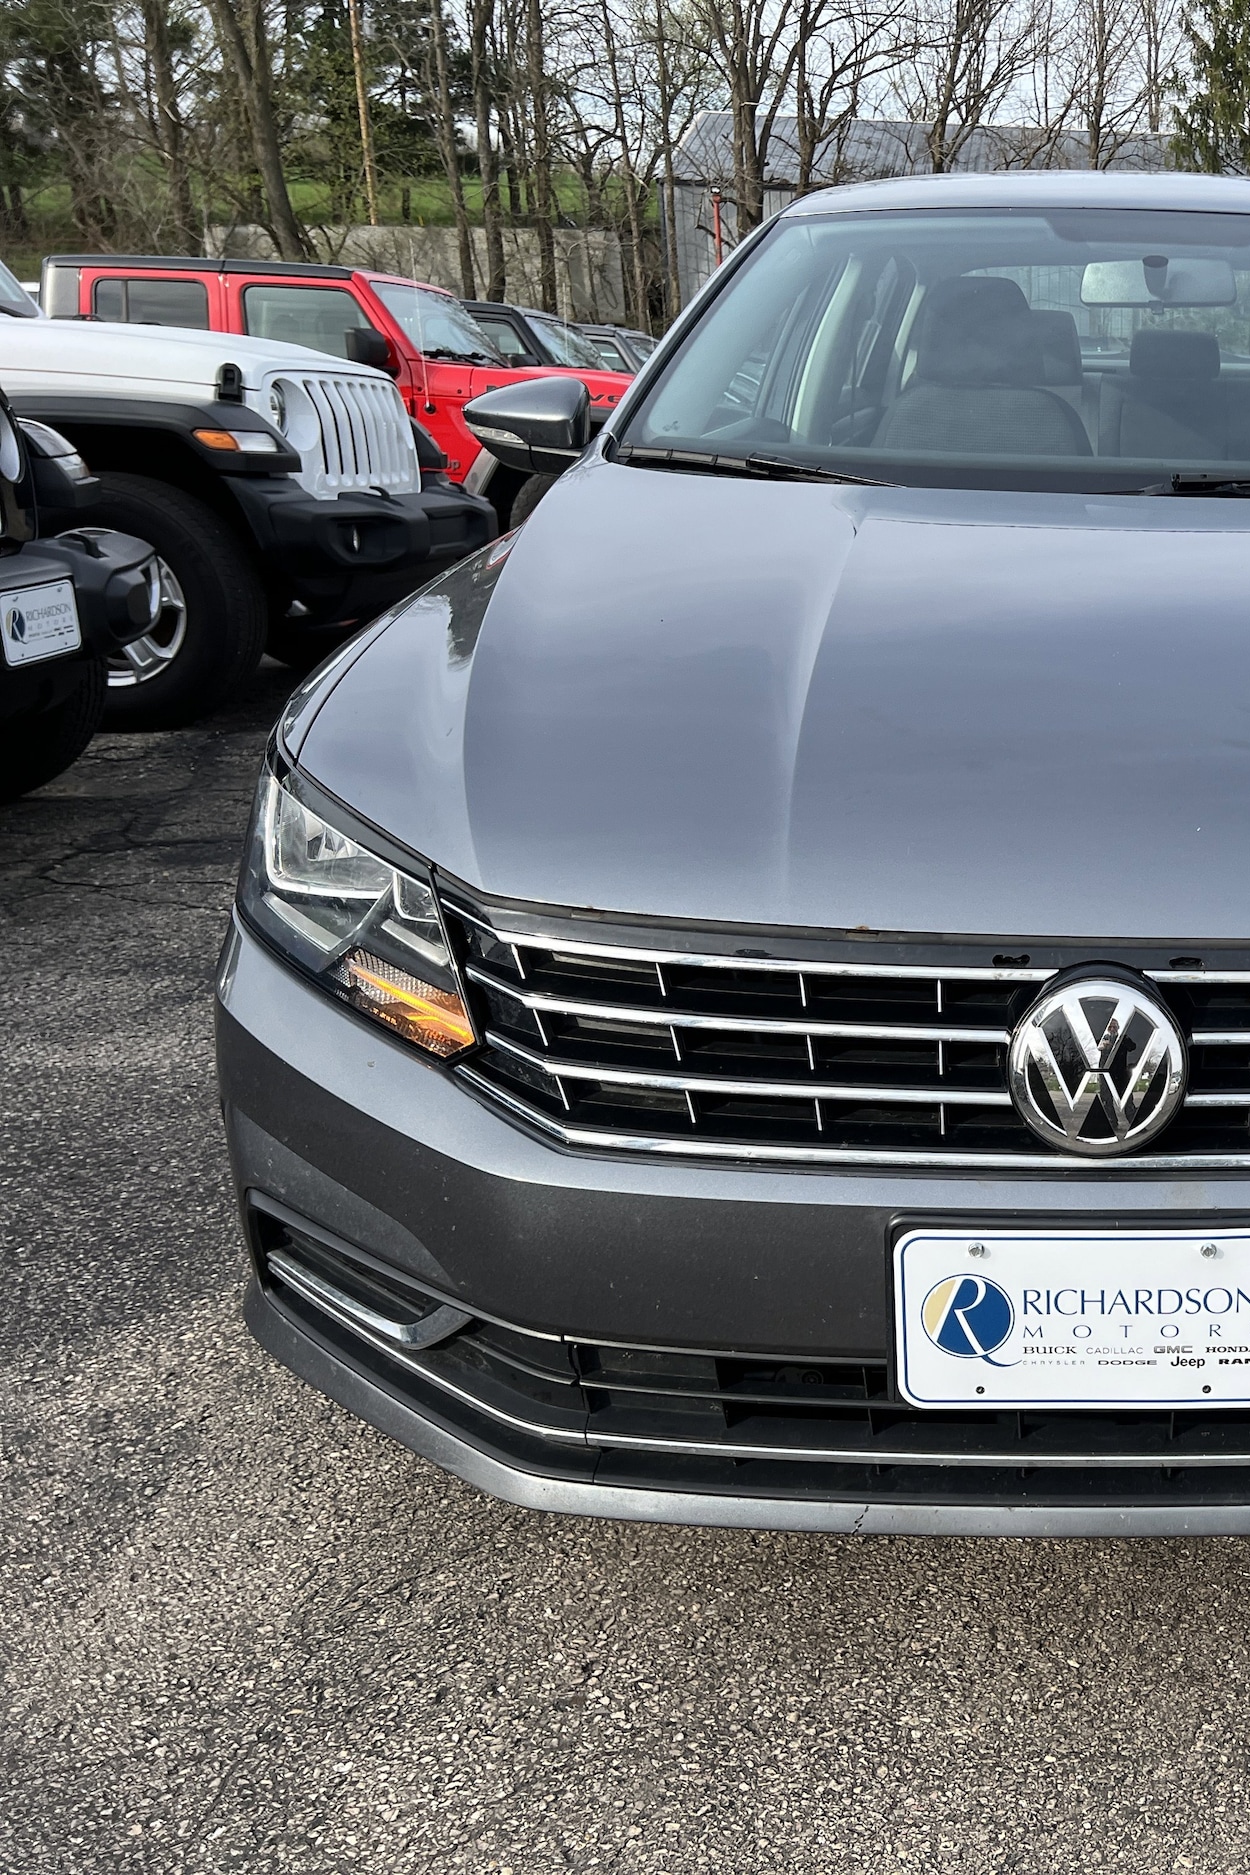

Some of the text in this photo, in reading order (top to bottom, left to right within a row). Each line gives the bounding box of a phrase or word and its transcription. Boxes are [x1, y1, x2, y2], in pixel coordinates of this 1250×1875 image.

[1014, 982, 1183, 1150] VW
[1022, 1345, 1077, 1354] BUICK
[1086, 1346, 1144, 1354] CADILLAC
[1153, 1345, 1193, 1354] GMC
[1170, 1355, 1206, 1369] Jeep
